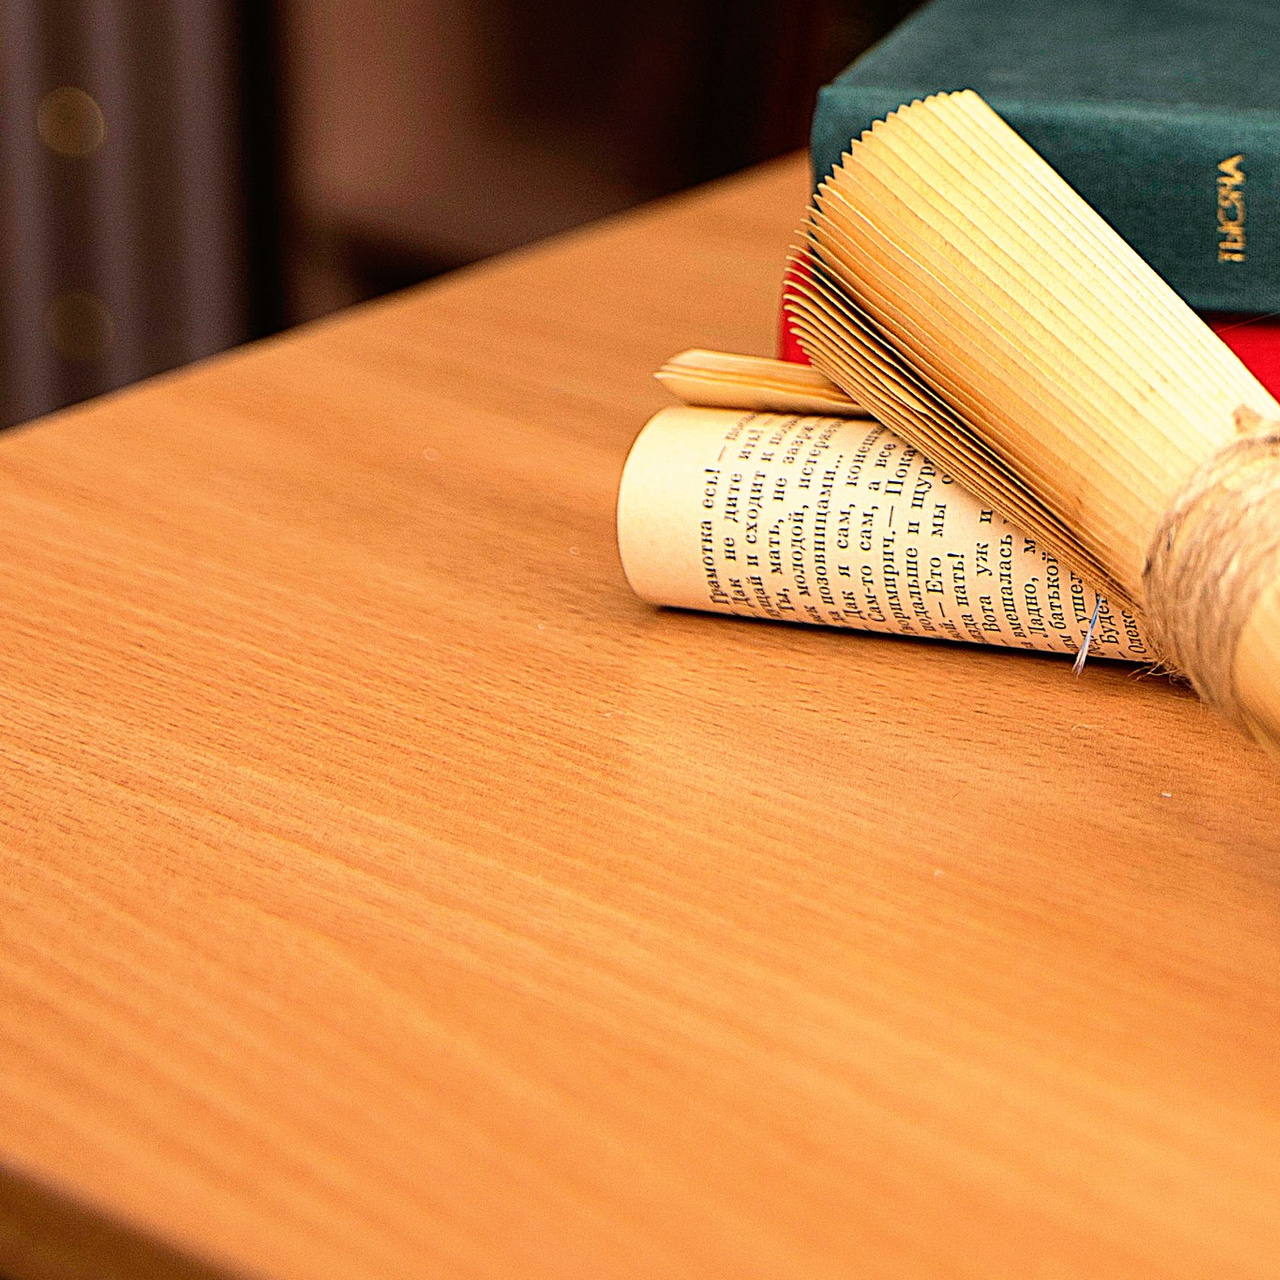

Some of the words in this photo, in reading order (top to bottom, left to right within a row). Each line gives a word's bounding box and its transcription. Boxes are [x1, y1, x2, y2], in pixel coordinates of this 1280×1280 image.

[1217, 154, 1246, 262] ТЫСЯЧА
[873, 444, 896, 468] все
[704, 468, 720, 509] есь!
[723, 473, 742, 523] дите
[772, 477, 787, 501] не
[867, 481, 881, 491] а
[745, 471, 766, 544] сходит
[836, 503, 855, 549] сам,
[931, 503, 946, 537] мы
[767, 518, 784, 575] мать,
[859, 506, 878, 551] сам,
[907, 521, 920, 534] и
[700, 520, 729, 605] Грамотка
[723, 537, 736, 561] не
[746, 555, 758, 567] и
[788, 505, 811, 596] молодой,
[976, 542, 992, 577] уж
[838, 565, 850, 577] я
[905, 547, 936, 631] подальше
[925, 557, 944, 595] Ето
[947, 553, 969, 606] пать!
[999, 535, 1027, 638] вмешалась
[728, 578, 753, 607] Дак
[775, 588, 795, 612] Ты,
[841, 591, 866, 620] Дак
[860, 565, 886, 622] Сам-то
[1023, 577, 1049, 638] Ладно,
[978, 596, 1001, 632] Вота
